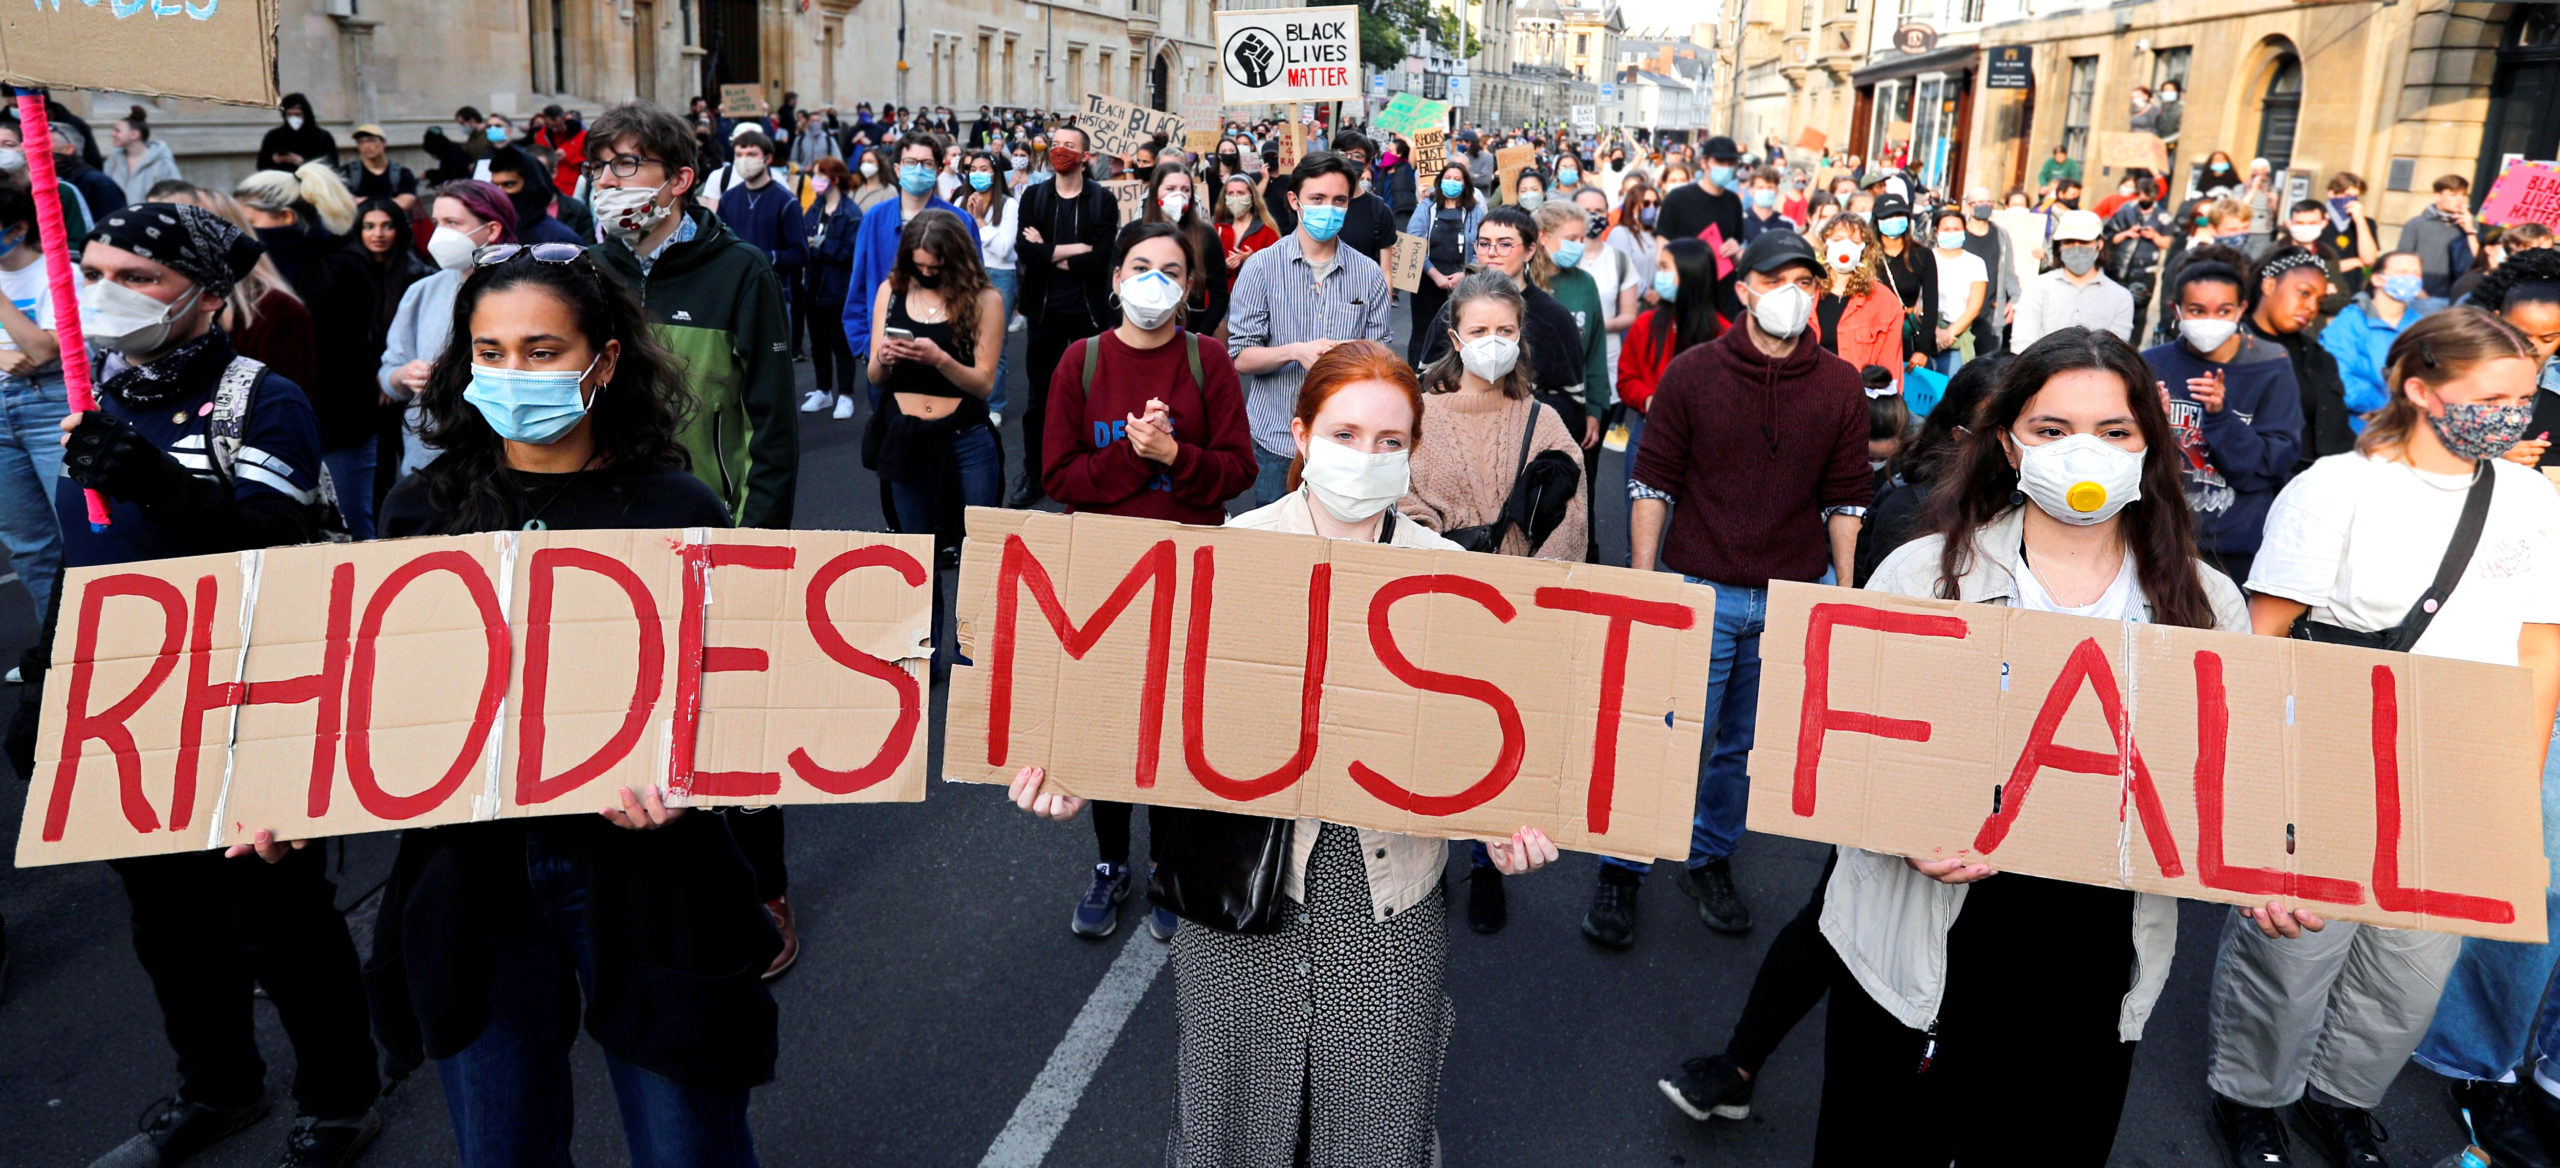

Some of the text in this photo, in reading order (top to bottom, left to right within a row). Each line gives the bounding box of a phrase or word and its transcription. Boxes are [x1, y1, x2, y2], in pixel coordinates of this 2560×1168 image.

[1286, 21, 1346, 41] BLACK
[1287, 44, 1348, 63] LIVES
[1287, 67, 1348, 87] MATTER
[1078, 112, 1137, 140] HISTORY IN
[1087, 94, 1185, 144] TEACH BLACK
[1091, 130, 1138, 157] SCHO
[1414, 130, 1443, 147] RHODES
[1418, 147, 1442, 161] MUST
[2527, 175, 2560, 195] BLAC
[2508, 203, 2560, 228] MATTER
[1408, 241, 1422, 280] RHODES
[42, 542, 928, 842] RHODES
[987, 533, 1696, 835] MUST
[1791, 602, 2516, 925] FALL
